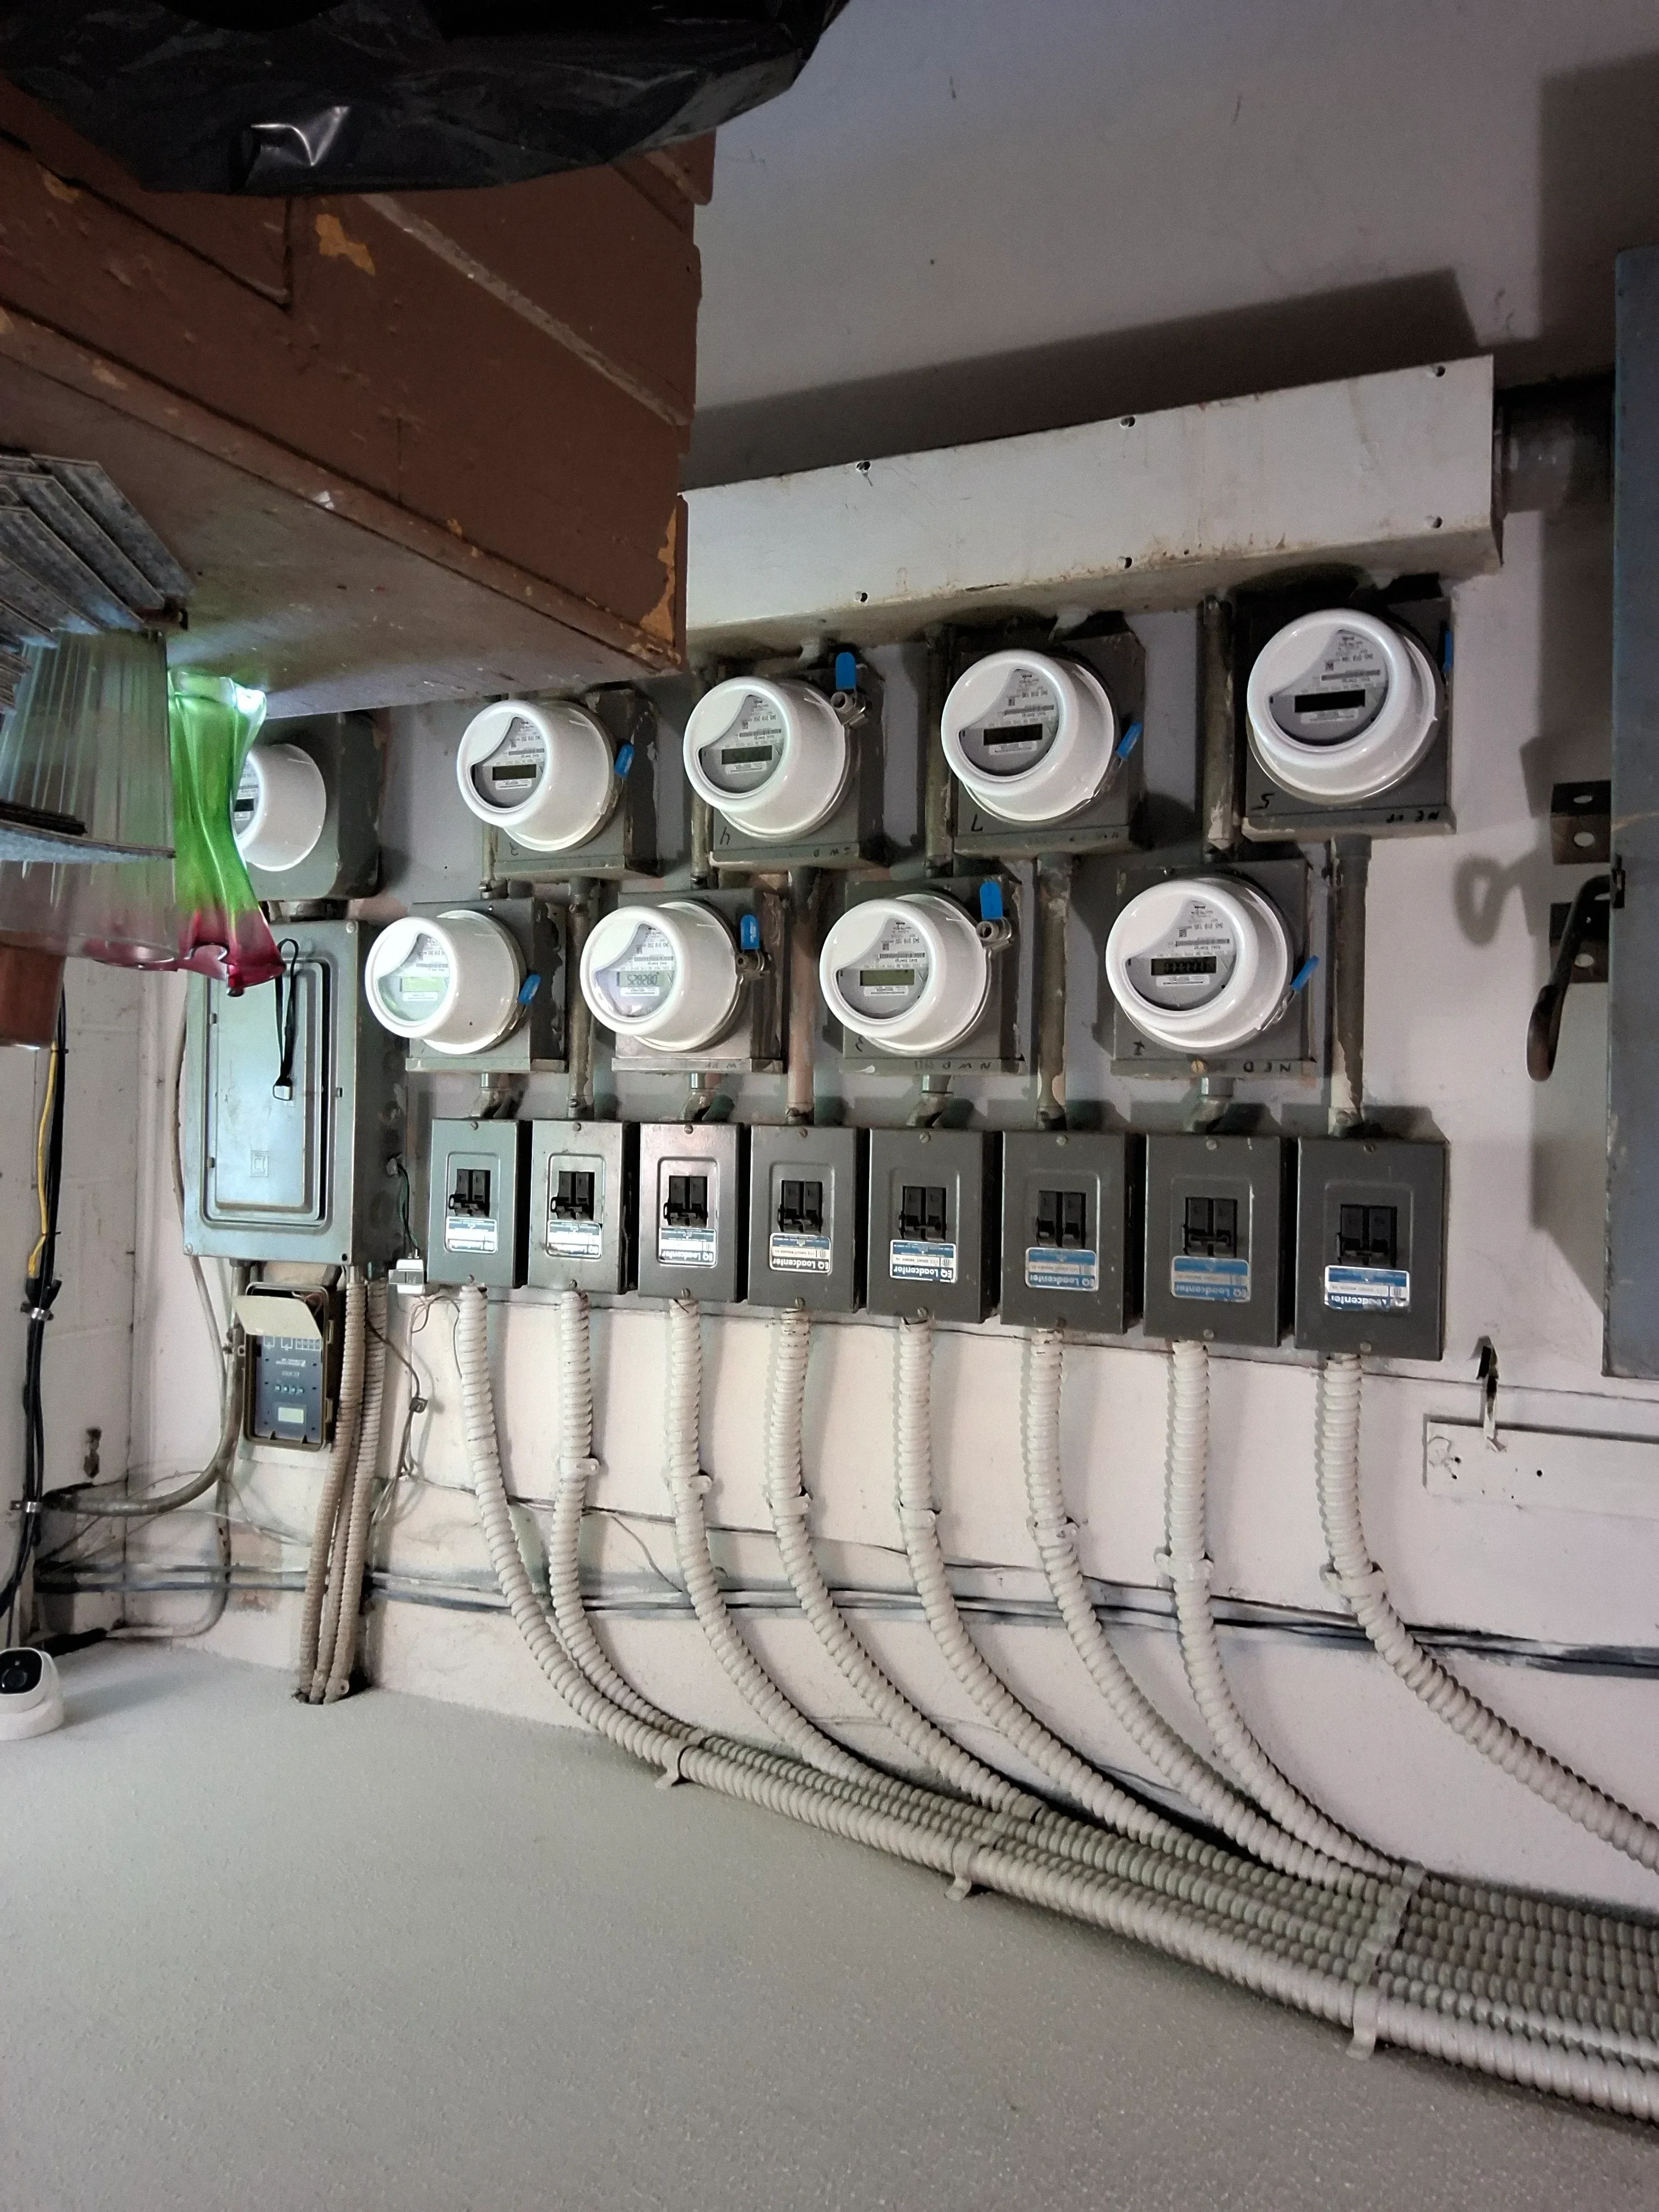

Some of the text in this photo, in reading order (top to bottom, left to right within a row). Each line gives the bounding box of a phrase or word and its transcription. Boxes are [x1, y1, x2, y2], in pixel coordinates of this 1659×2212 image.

[970, 813, 983, 832] 7
[773, 1258, 828, 1269] EQ Loadcenter
[893, 1266, 952, 1278] EQ Loadcenter
[1030, 1274, 1079, 1286] Loadcenter
